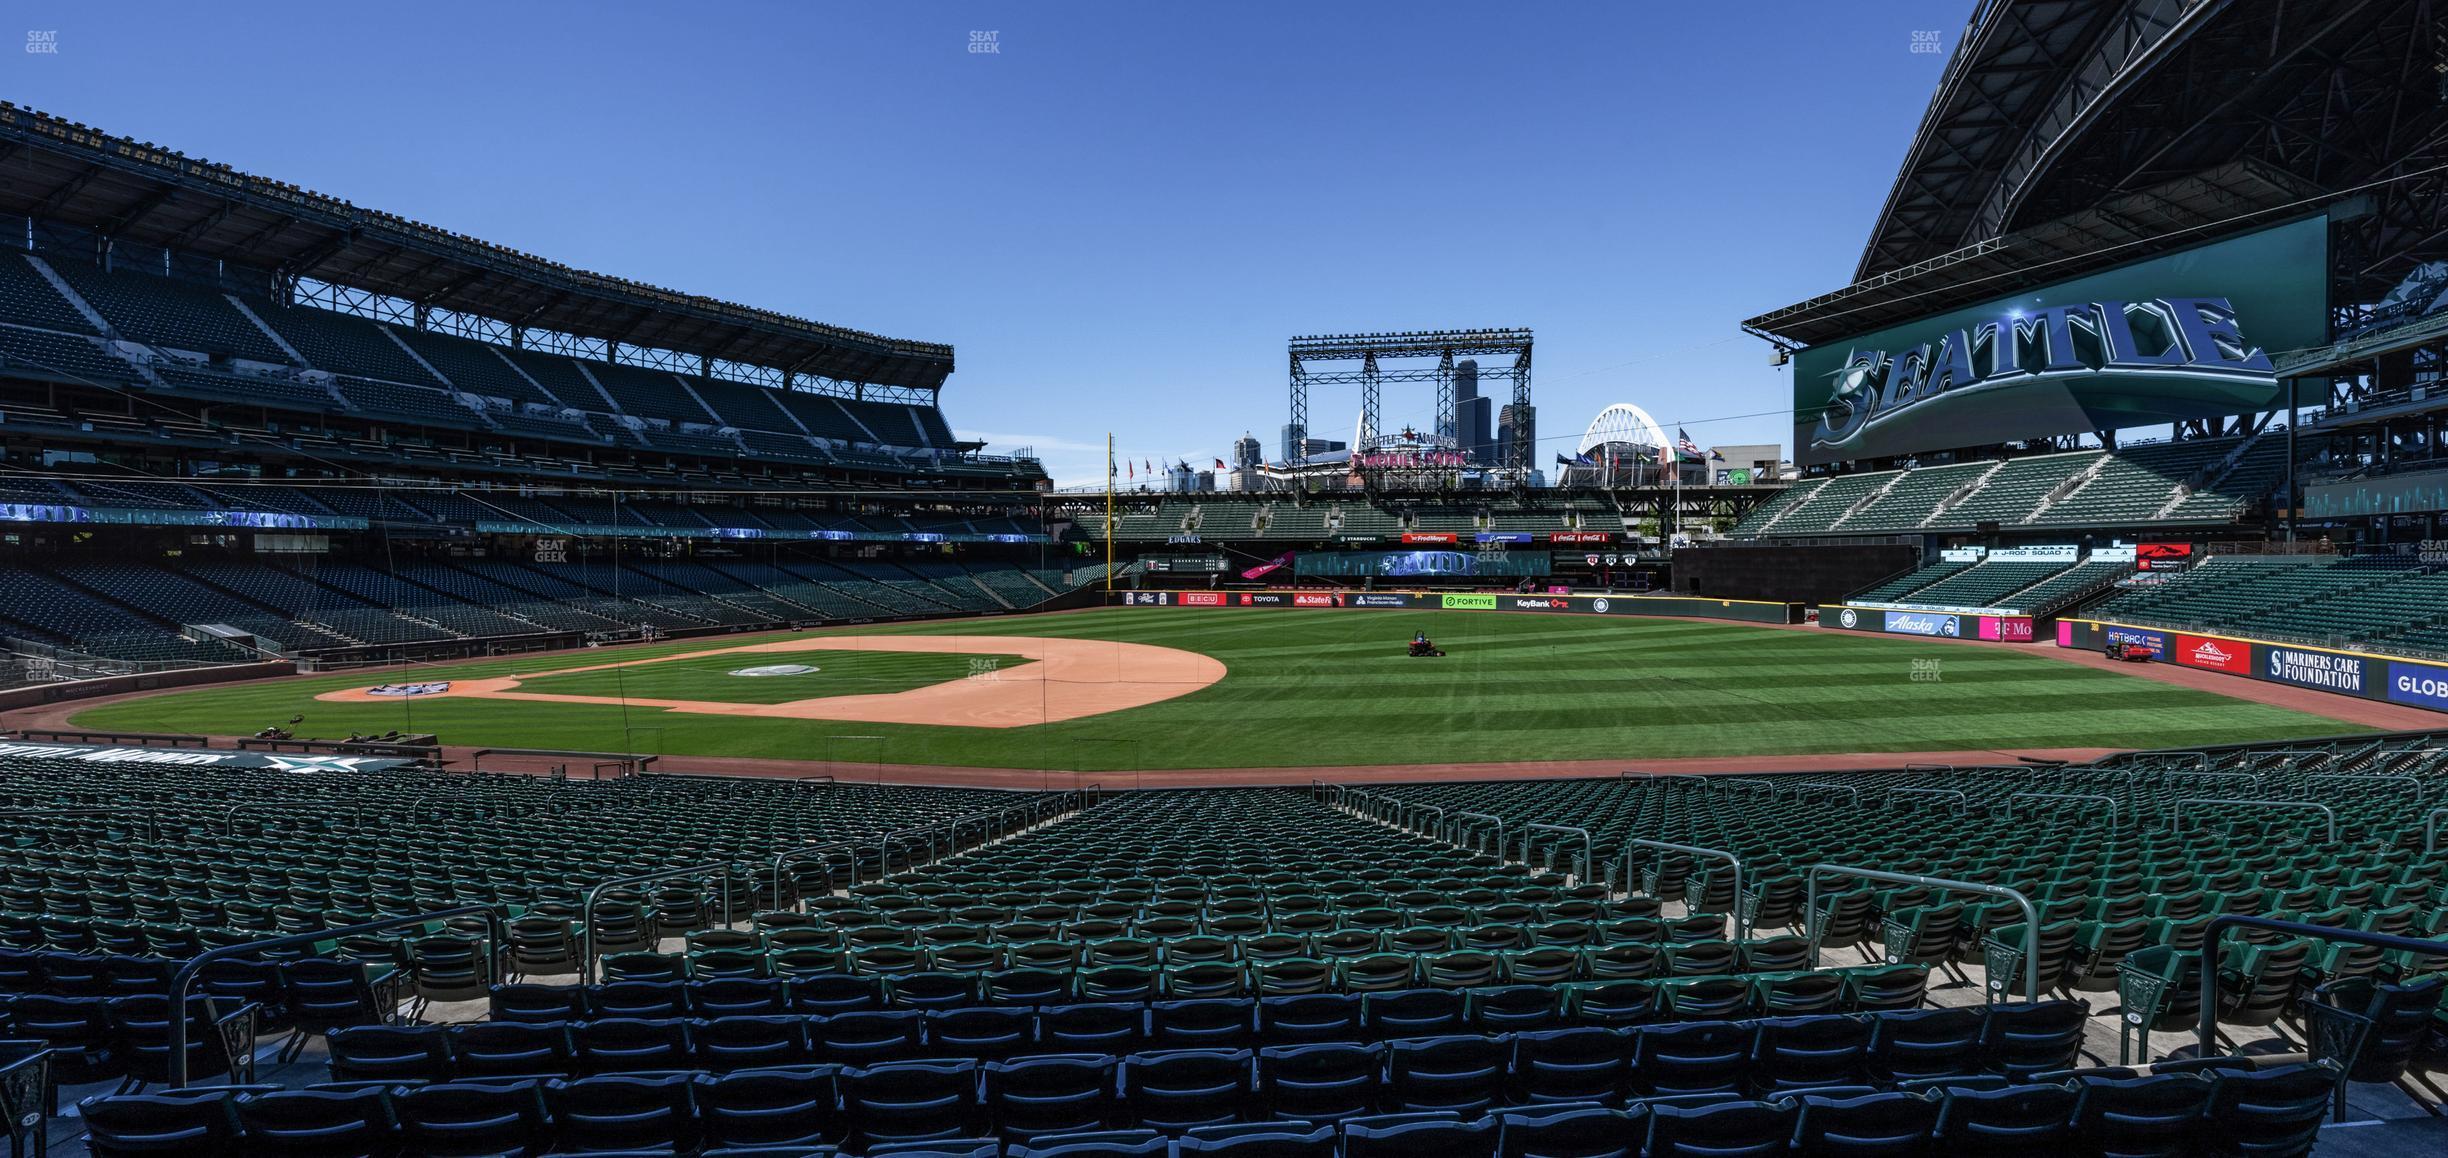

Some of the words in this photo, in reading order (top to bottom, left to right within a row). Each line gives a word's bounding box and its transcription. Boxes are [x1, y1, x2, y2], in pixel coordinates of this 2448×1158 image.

[1810, 298, 2278, 448] SEATTLE
[1190, 594, 1216, 603] BECU
[1457, 598, 1493, 606] FORTIVE
[1517, 599, 1550, 608] KeyBank
[1888, 615, 1934, 633] Alaska
[2285, 651, 2331, 671] MARINERS
[2334, 657, 2360, 674] CARE
[2285, 665, 2360, 690] FOUNDATION
